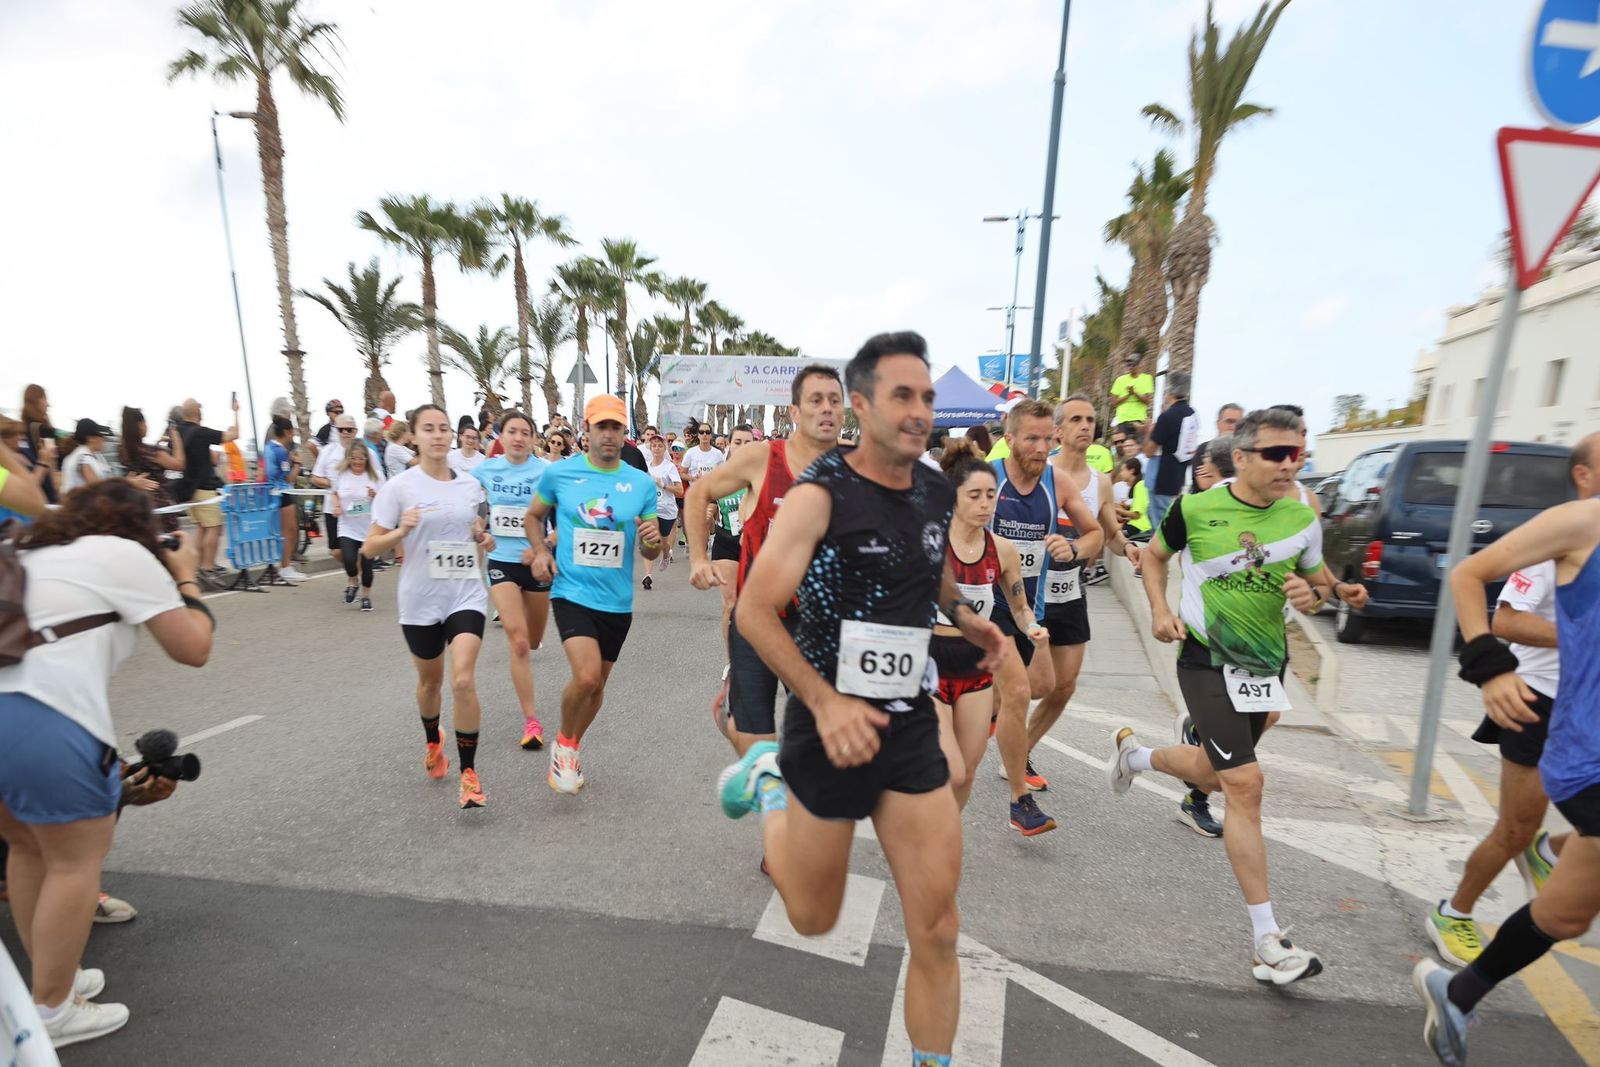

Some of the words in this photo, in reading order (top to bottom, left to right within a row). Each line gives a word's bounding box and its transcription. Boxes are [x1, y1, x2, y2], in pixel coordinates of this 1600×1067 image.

[493, 482, 532, 496] nerja
[999, 519, 1046, 531] Ballymena
[997, 527, 1046, 539] runners
[579, 541, 620, 557] 1271
[435, 554, 475, 568] 1185
[1051, 580, 1074, 594] 596
[860, 650, 913, 677] 630
[1238, 682, 1271, 698] 497
